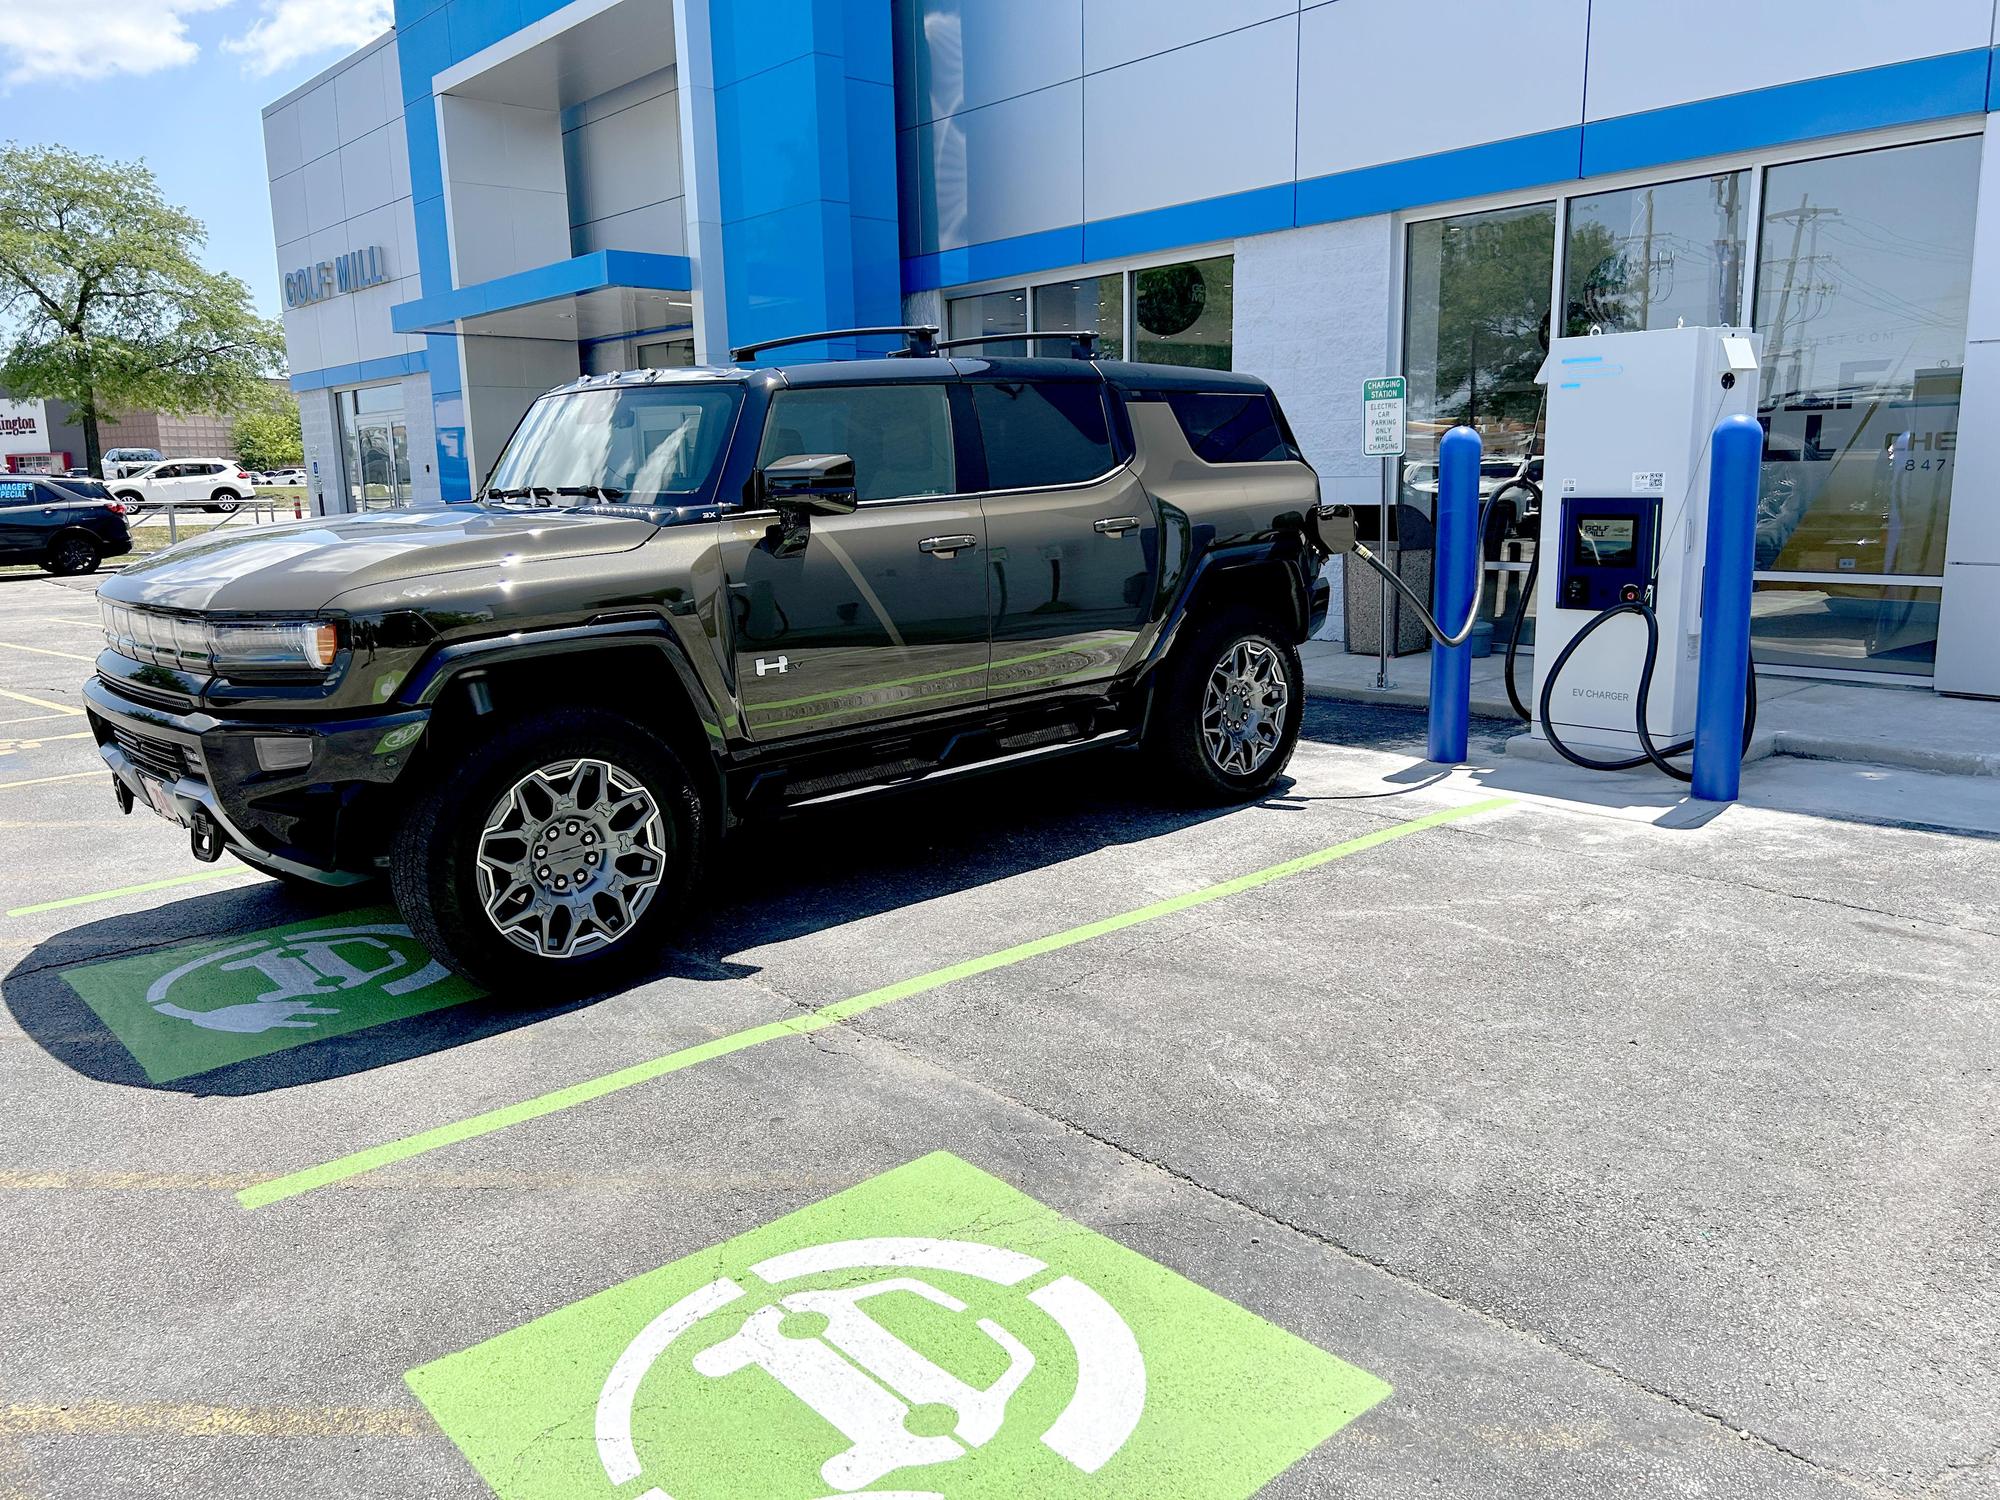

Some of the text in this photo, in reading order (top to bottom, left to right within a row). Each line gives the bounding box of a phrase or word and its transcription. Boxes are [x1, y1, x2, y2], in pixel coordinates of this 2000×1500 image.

[284, 246, 385, 307] GOLF MILL
[1367, 380, 1400, 390] CHARGING
[1371, 390, 1397, 399] STATION
[1370, 402, 1397, 410] ELECTRIC
[0, 483, 33, 491] NAGER'S
[1572, 688, 1629, 701] EV CHARGER
